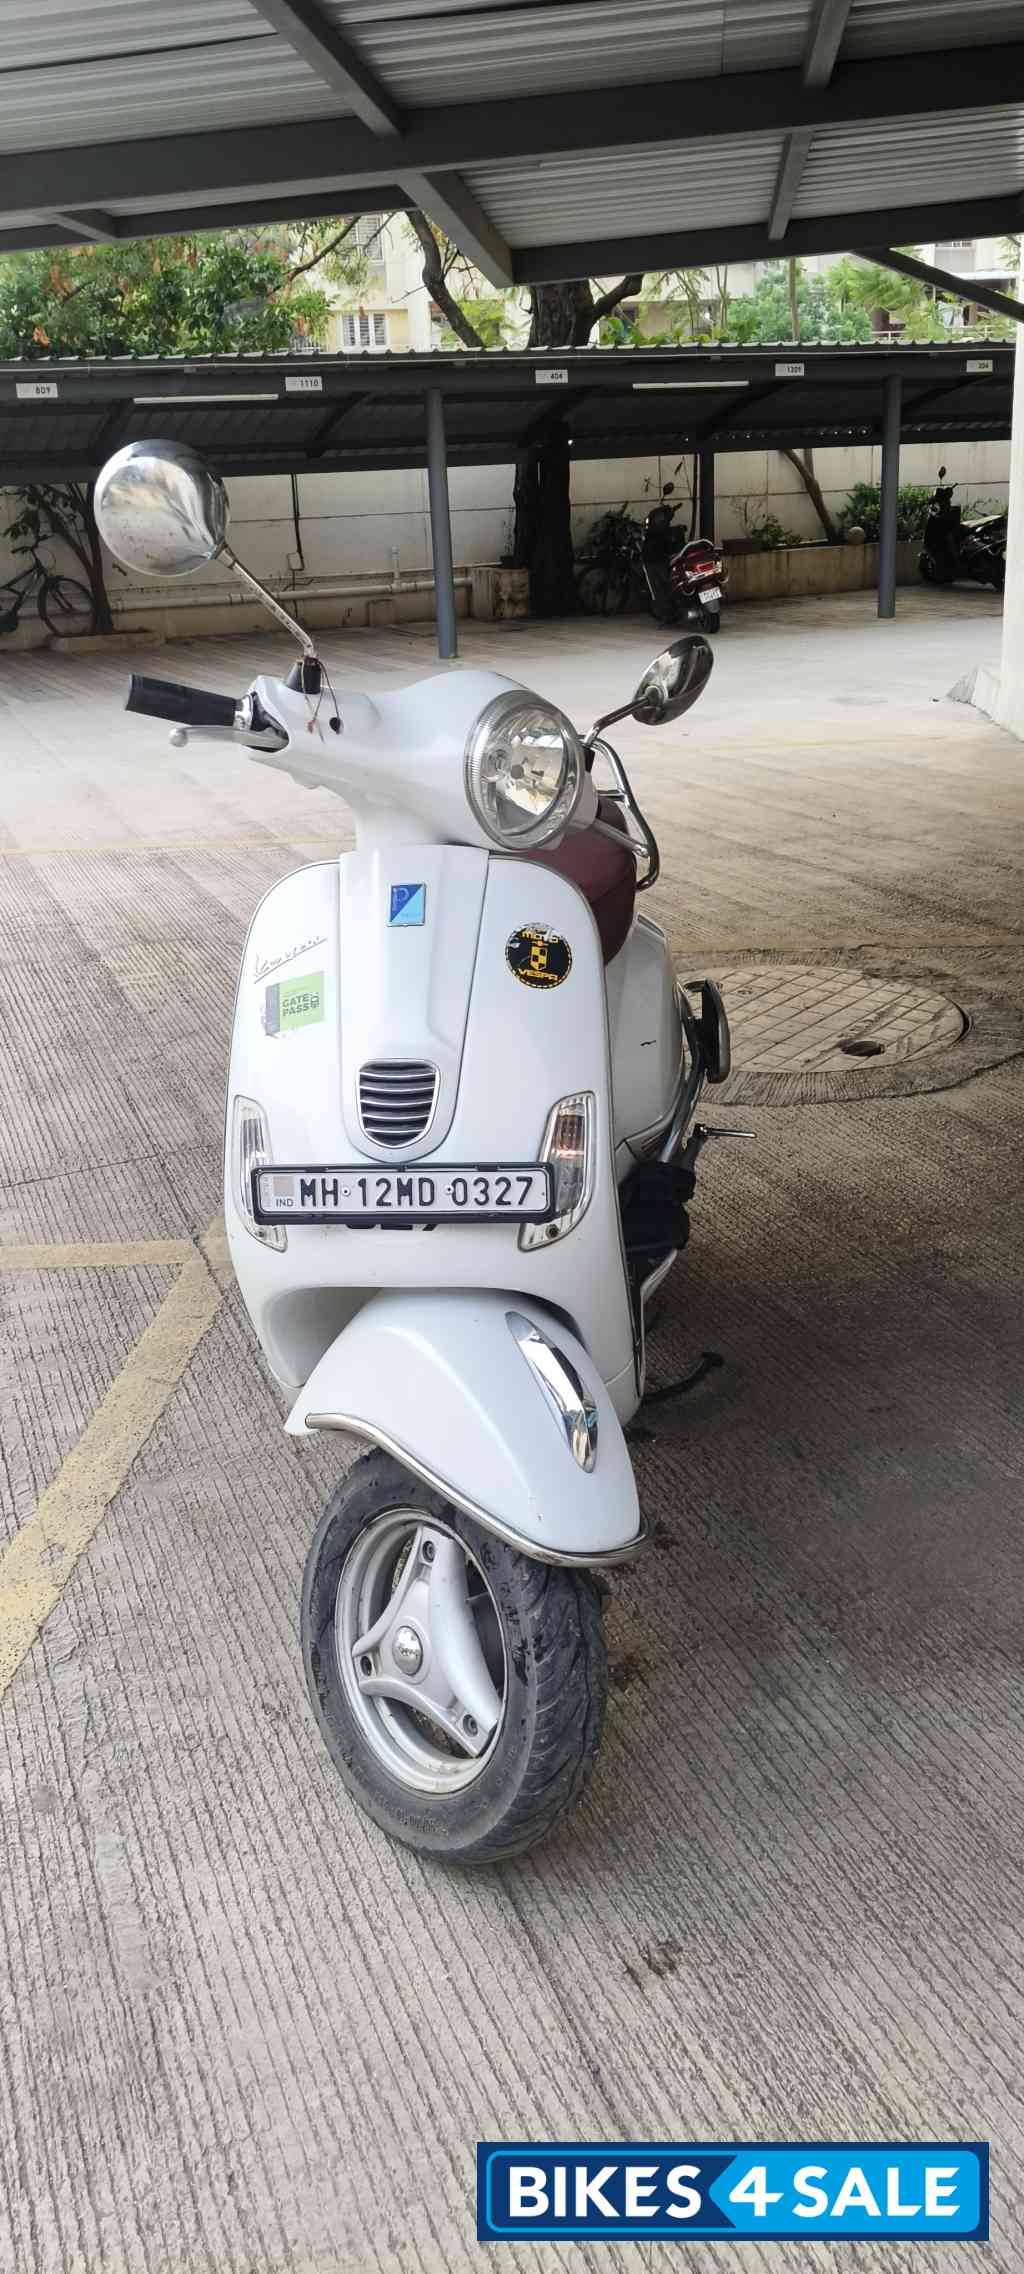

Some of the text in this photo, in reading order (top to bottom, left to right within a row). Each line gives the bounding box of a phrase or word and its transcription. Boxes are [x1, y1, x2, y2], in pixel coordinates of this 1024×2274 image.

[518, 968, 560, 981] VESPA
[282, 993, 310, 1008] GATE
[282, 1003, 310, 1017] PASS
[276, 1198, 294, 1207] IND
[300, 1178, 339, 1207] MH
[451, 1176, 534, 1207] 0327
